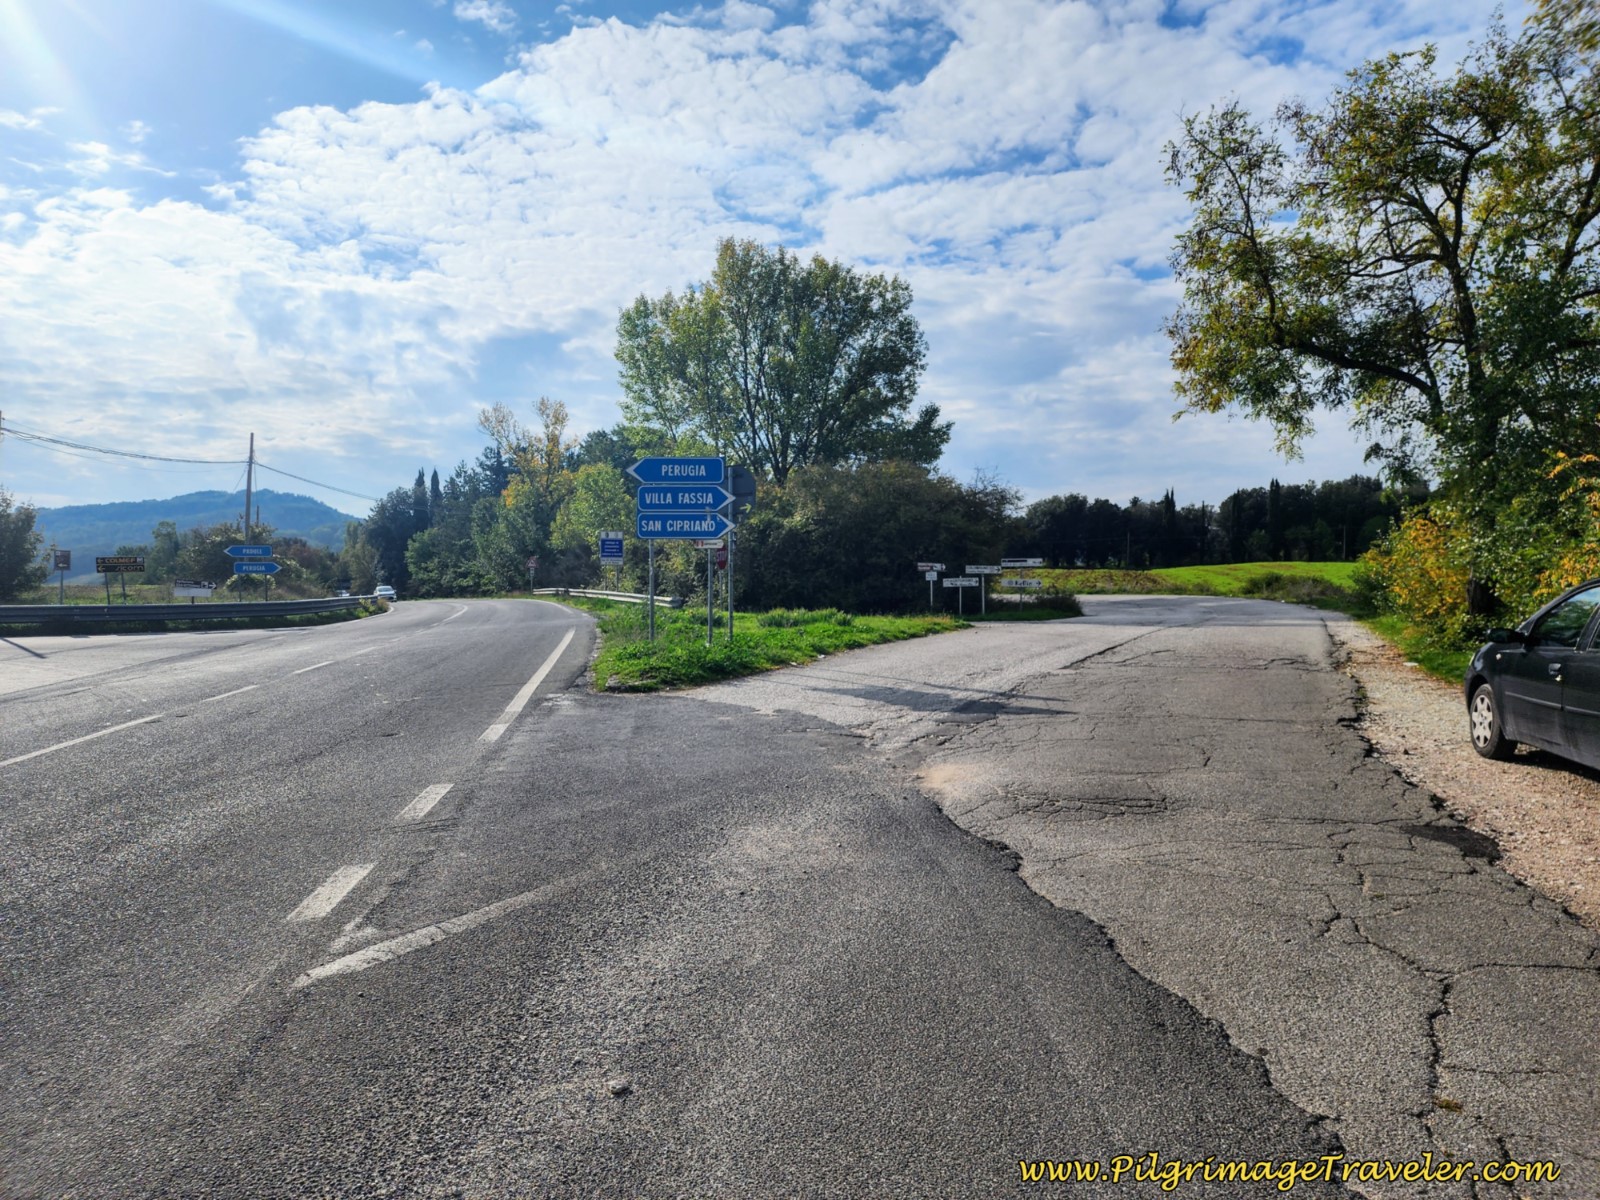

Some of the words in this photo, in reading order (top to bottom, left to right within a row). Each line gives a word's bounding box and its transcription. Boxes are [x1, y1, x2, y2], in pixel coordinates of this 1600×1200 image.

[661, 464, 706, 477] PERUGIA
[645, 493, 673, 504] VILLA
[678, 493, 713, 504] FASSIA
[641, 520, 662, 532] SAN
[666, 520, 716, 532] CIPRIANO
